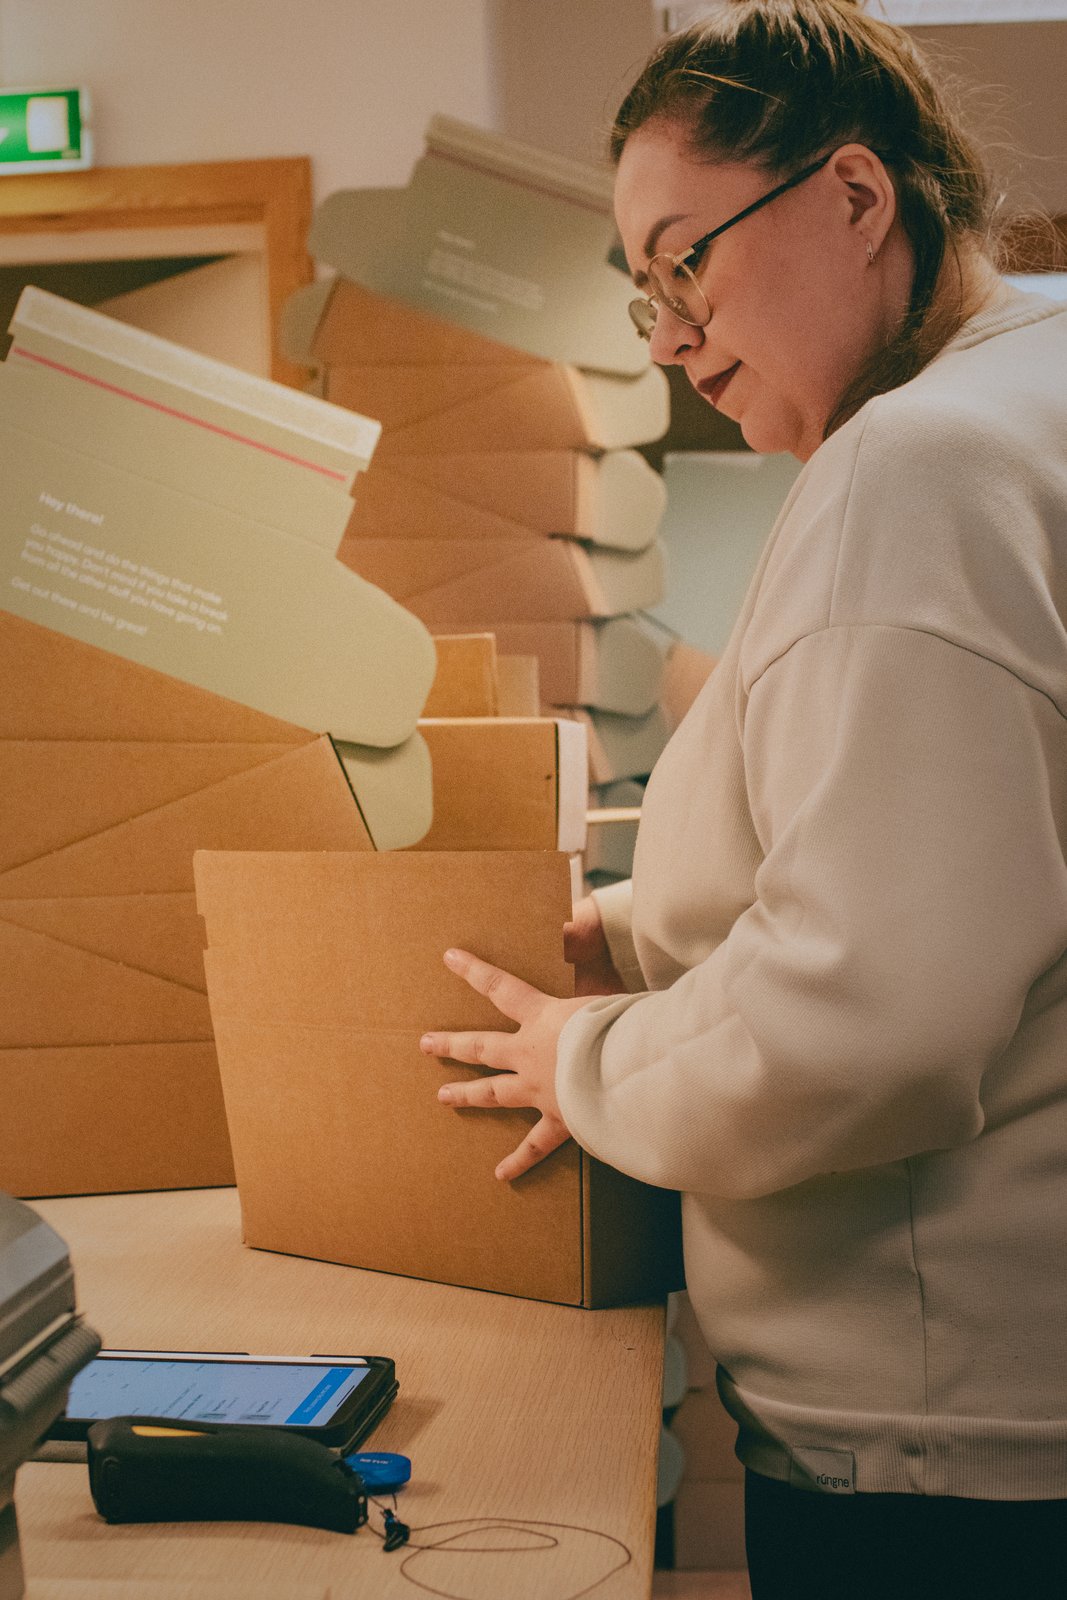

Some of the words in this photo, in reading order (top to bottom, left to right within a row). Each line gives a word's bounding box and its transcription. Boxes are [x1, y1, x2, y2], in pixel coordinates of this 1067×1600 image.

[39, 492, 64, 511] Hey
[66, 502, 104, 525] there!
[816, 1473, 849, 1488] rúngne
